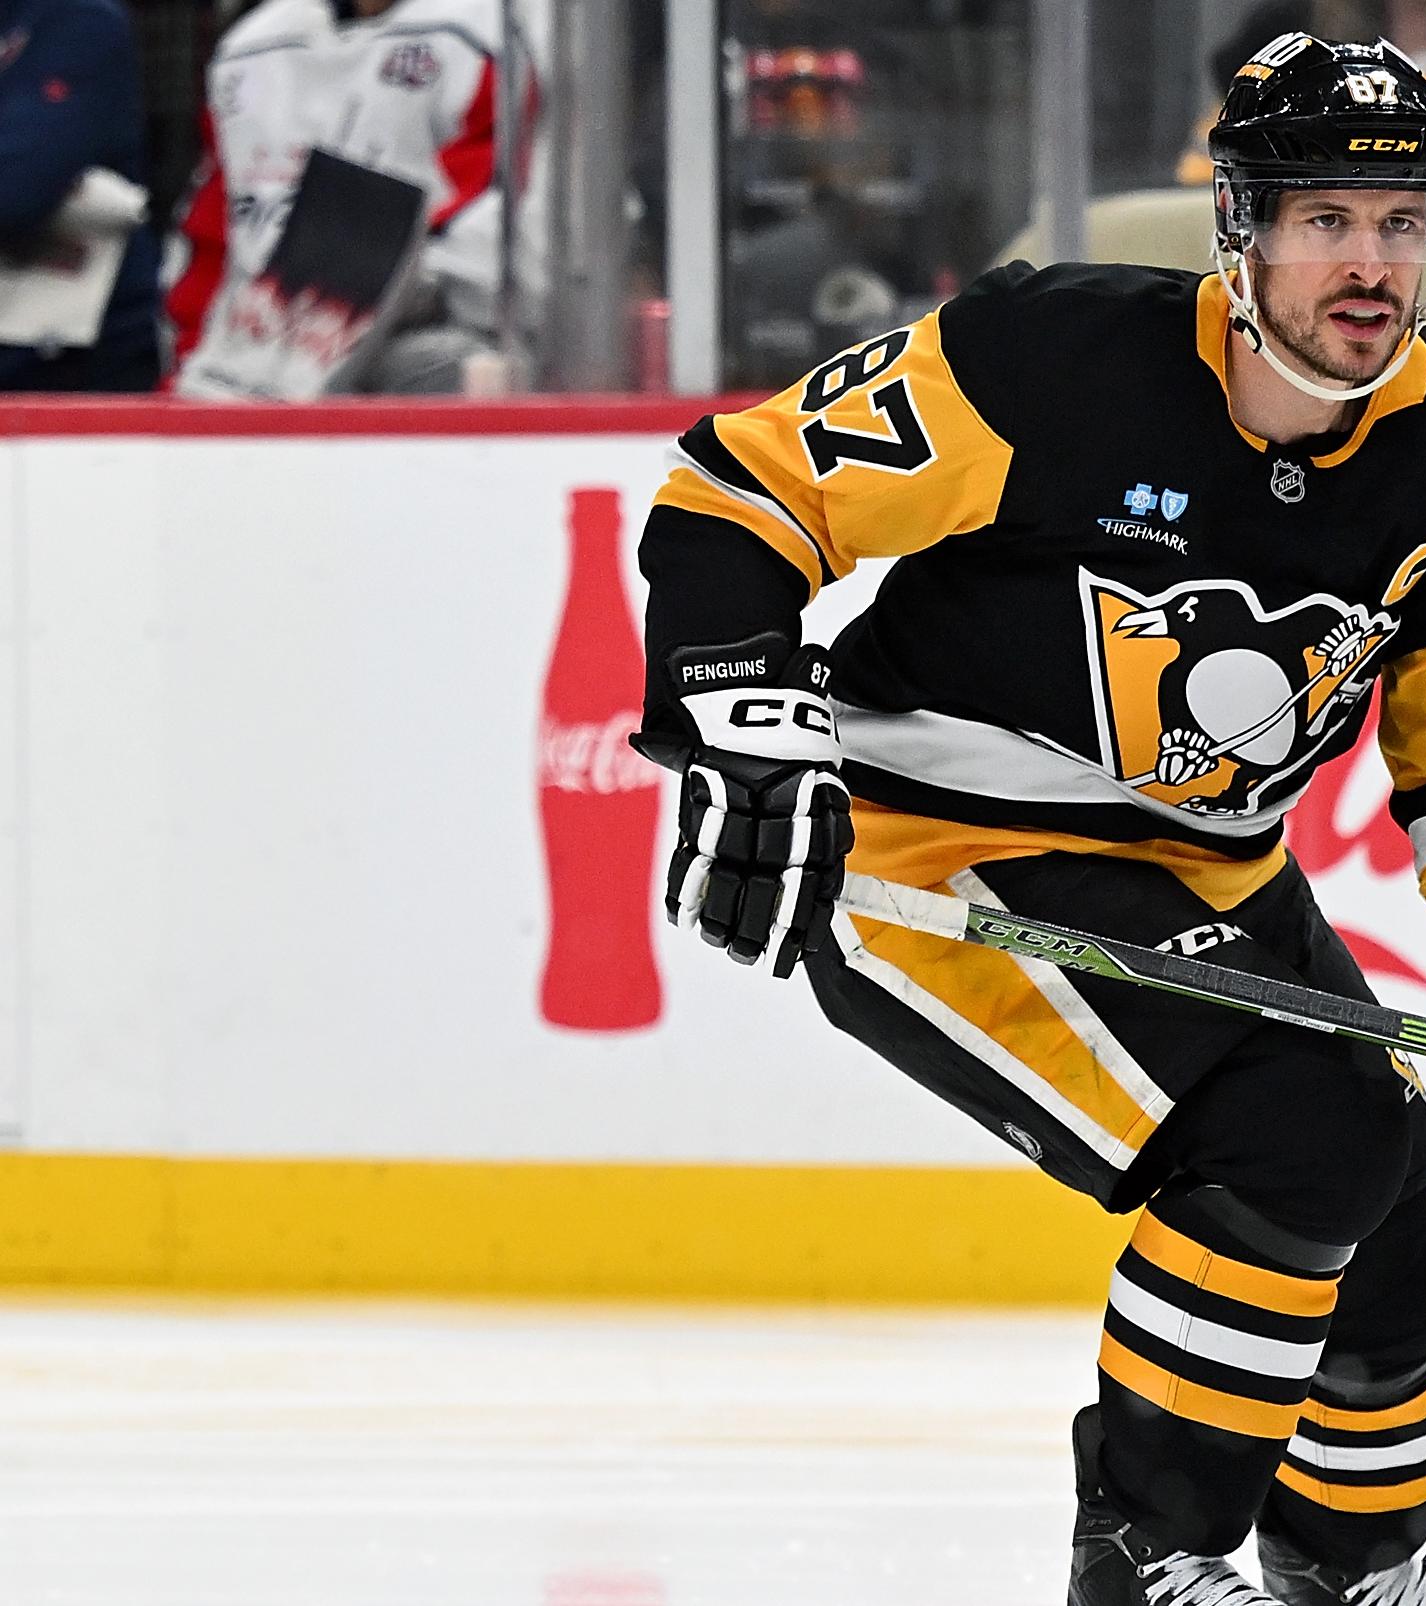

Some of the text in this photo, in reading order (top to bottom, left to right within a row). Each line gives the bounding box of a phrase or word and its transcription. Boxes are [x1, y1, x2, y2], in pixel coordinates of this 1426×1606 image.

[1345, 71, 1399, 105] 87
[1348, 138, 1419, 153] CCM
[796, 325, 939, 484] 87
[1278, 474, 1298, 491] NHL
[682, 655, 767, 683] PENGUINS
[810, 661, 831, 689] 87
[977, 917, 1091, 958] CCM
